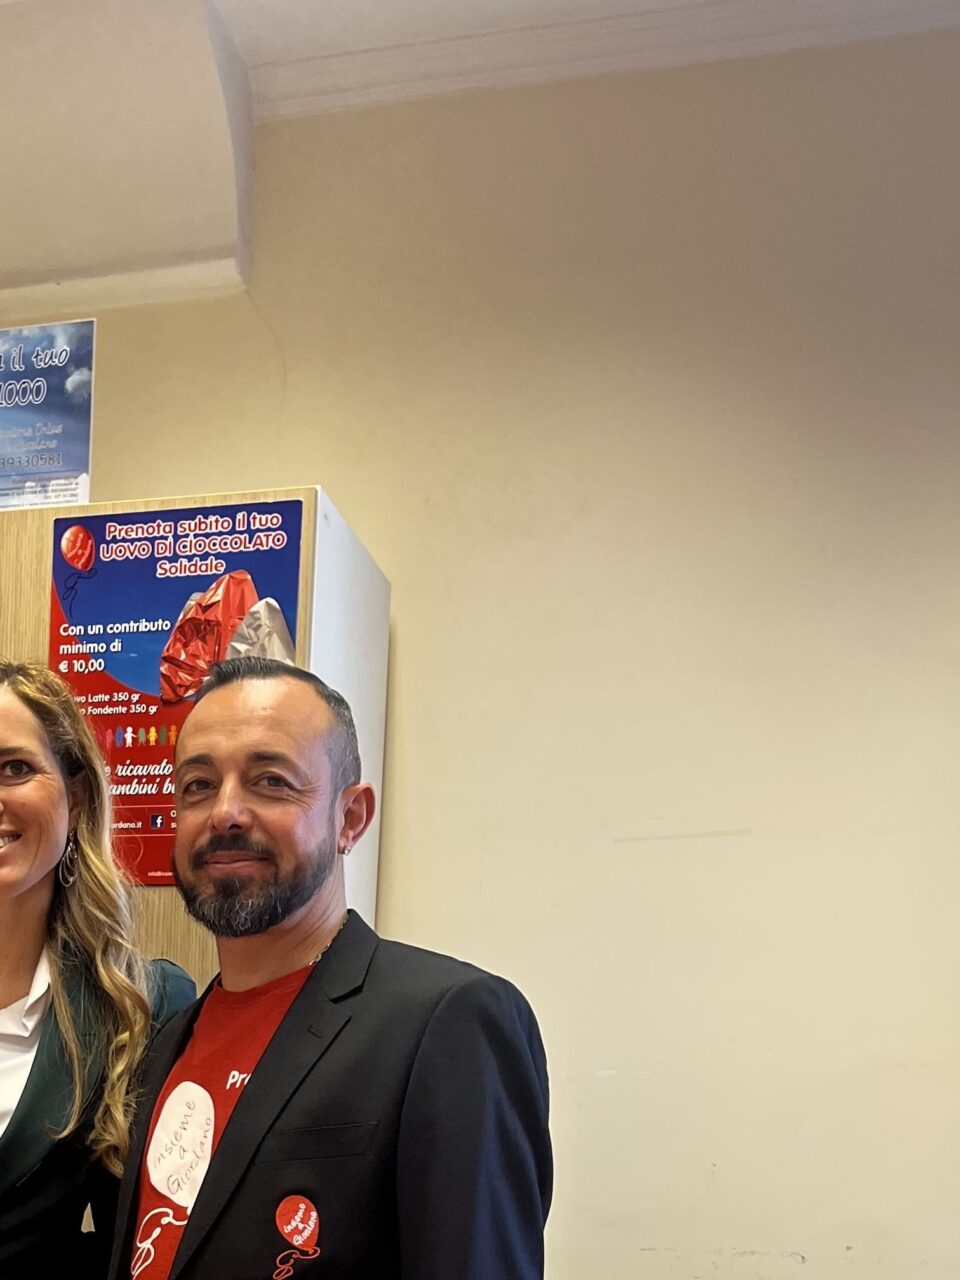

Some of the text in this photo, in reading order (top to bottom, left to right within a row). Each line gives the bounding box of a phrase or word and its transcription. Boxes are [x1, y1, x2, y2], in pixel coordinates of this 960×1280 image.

[11, 345, 24, 371] il
[34, 346, 69, 367] tuo
[106, 511, 282, 540] Prenota subito il tuo
[100, 530, 288, 560] UOVO DI CIOCCOLATO
[156, 557, 226, 578] Solidale
[59, 619, 172, 636] Con un contributo
[59, 639, 122, 655] minimo di
[59, 658, 105, 673] € 10,00
[88, 692, 140, 702] Latte 350 gr
[87, 704, 158, 715] Fondente 350 gr
[115, 759, 173, 776] ricavato
[166, 1115, 213, 1196] Giordano
[292, 1210, 318, 1246] Giordano
